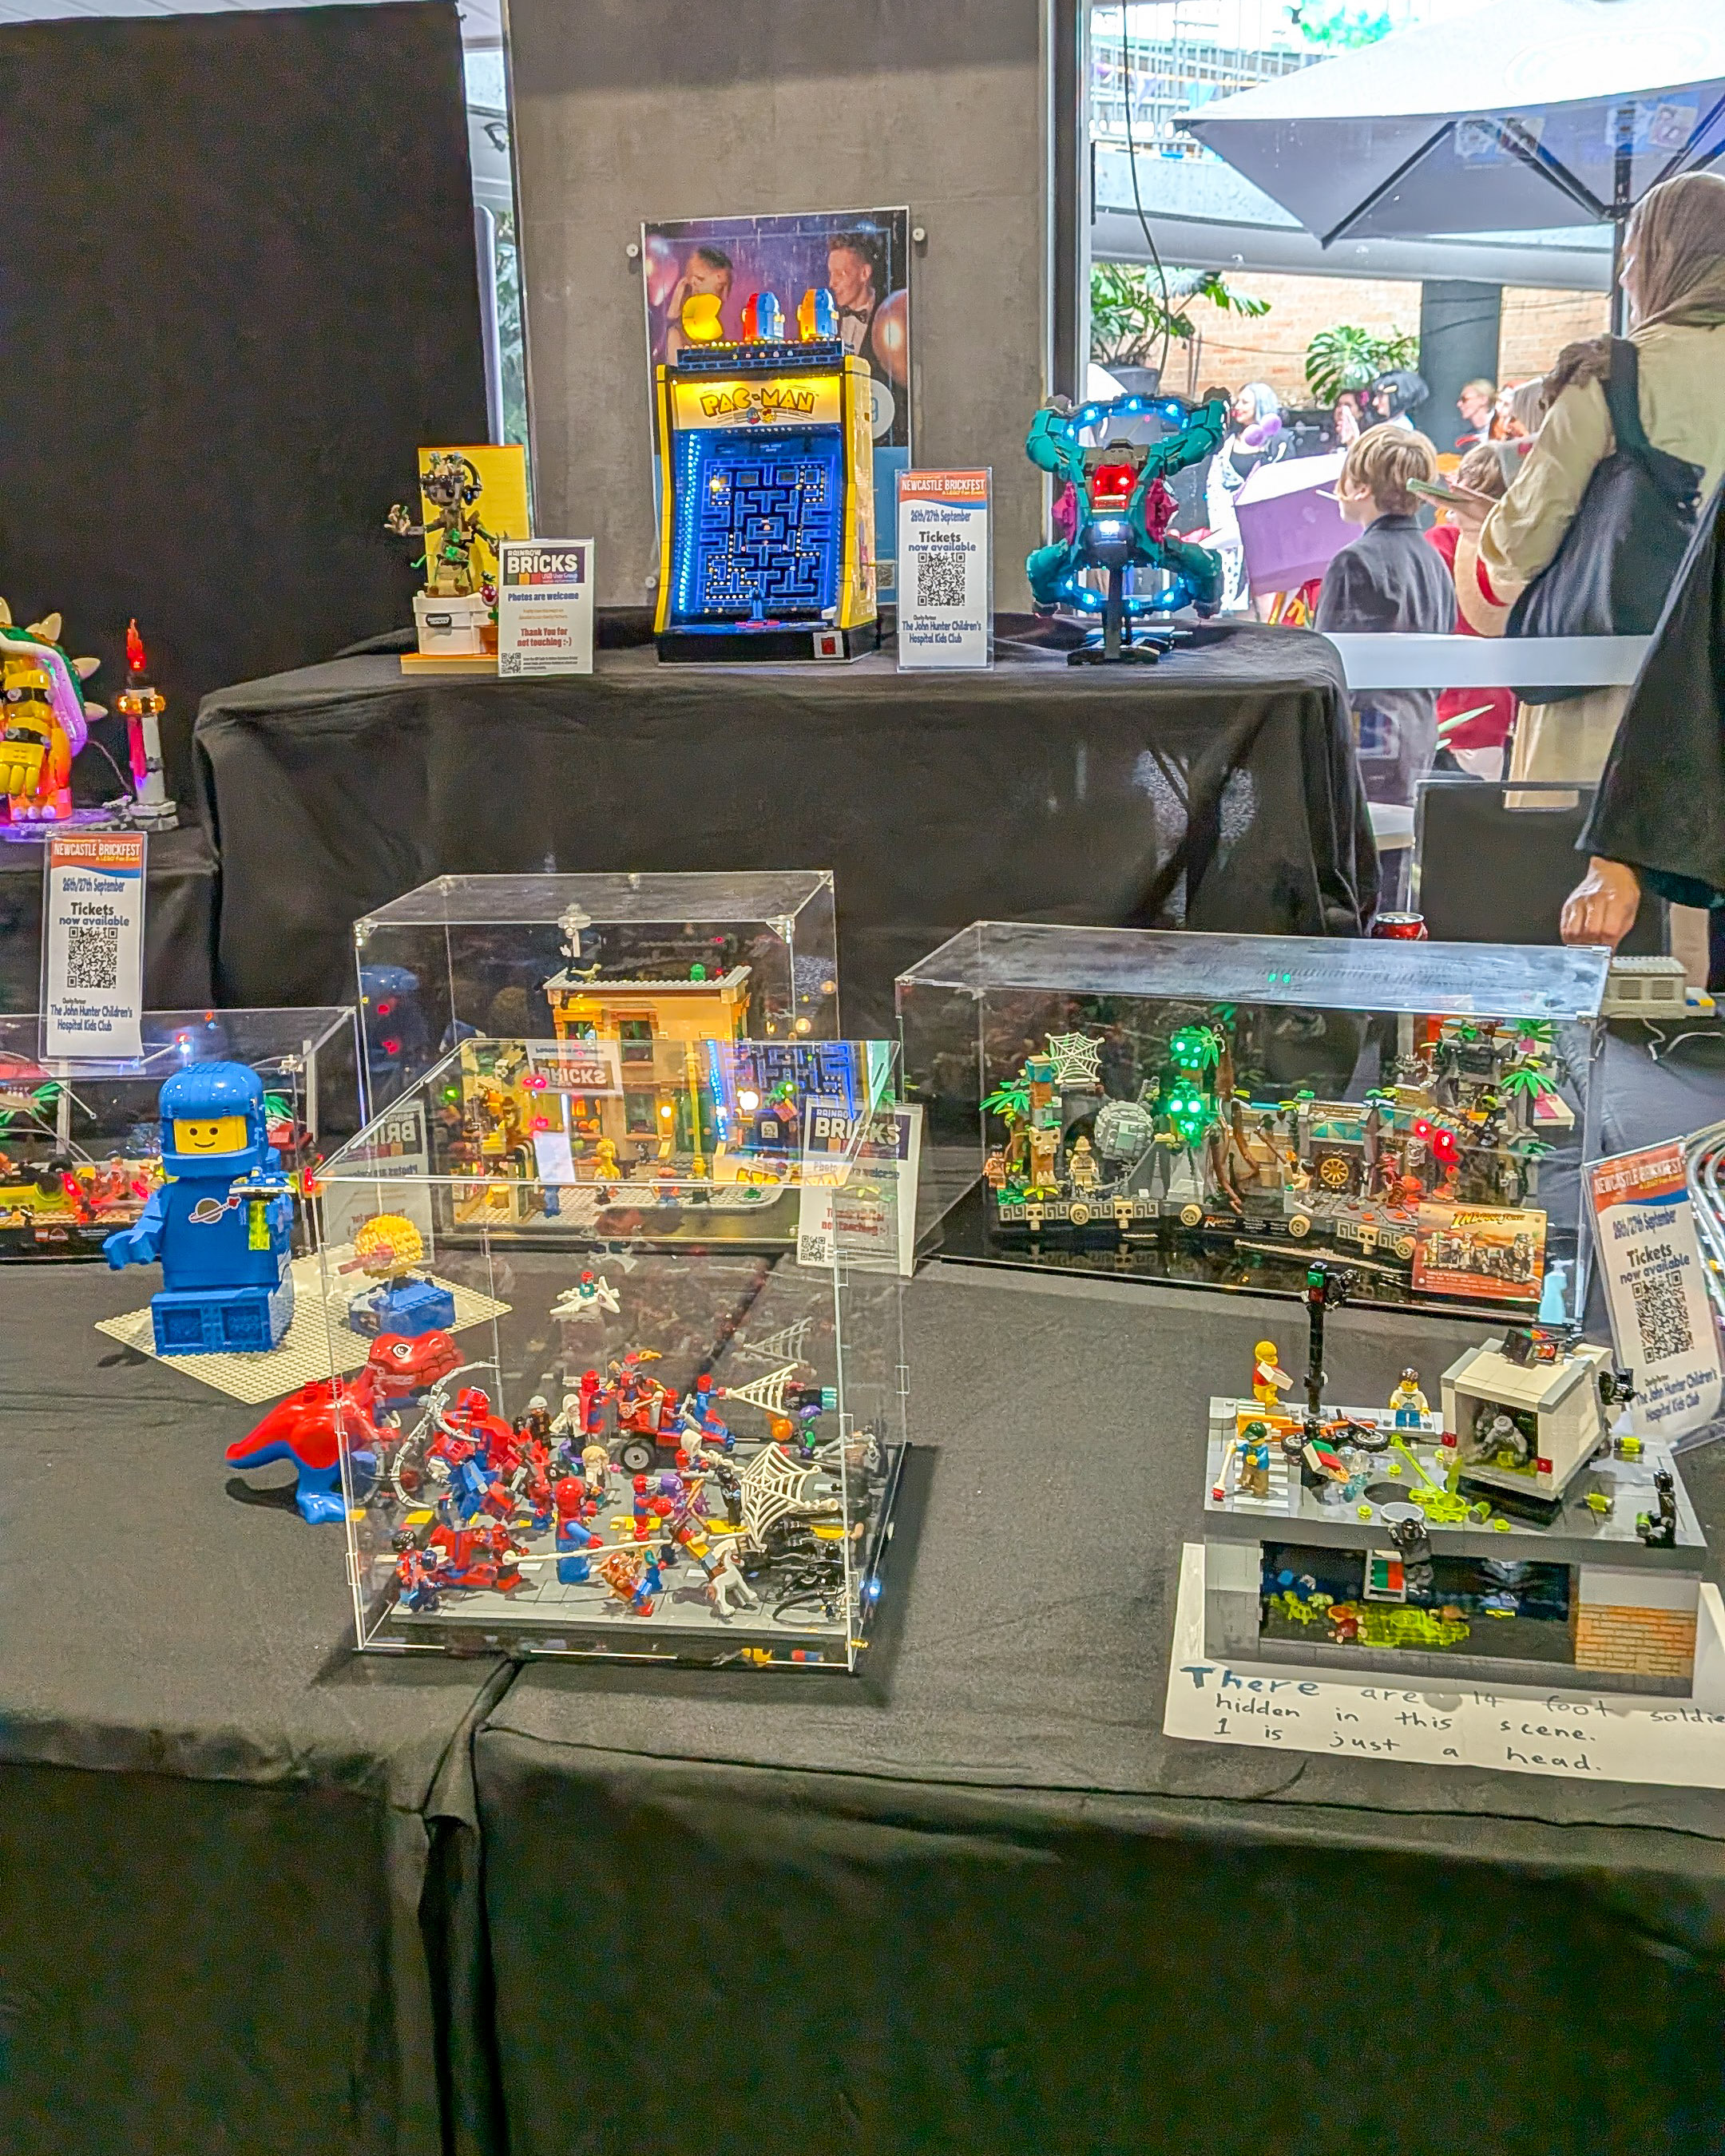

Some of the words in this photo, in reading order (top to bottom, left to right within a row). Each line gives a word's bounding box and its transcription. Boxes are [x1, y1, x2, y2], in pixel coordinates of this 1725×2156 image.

[700, 387, 815, 418] PAC-MAN
[902, 479, 942, 491] NEWCASTLE
[945, 479, 985, 490] BRICKFEST
[941, 509, 971, 525] September
[919, 531, 961, 543] Tickets
[931, 542, 976, 552] available
[507, 554, 577, 574] BRICKS
[508, 593, 532, 601] Photos
[547, 592, 579, 600] welcome
[521, 628, 542, 636] Thank
[543, 628, 556, 636] You
[557, 627, 568, 636] for
[902, 620, 913, 631] The
[914, 621, 929, 631] John
[930, 621, 950, 631] Hunter
[952, 620, 981, 631] Children's
[530, 637, 561, 648] touching
[909, 633, 934, 645] Hospital
[934, 633, 947, 643] Kids
[948, 633, 962, 644] Club
[54, 842, 96, 856] NEWCASTLE
[98, 843, 141, 856] BRICKFEST
[93, 878, 125, 896] September
[70, 902, 114, 915] Tickets
[59, 917, 80, 925] now
[82, 915, 129, 926] available
[50, 1004, 62, 1016] The
[63, 1005, 78, 1017] John
[80, 1005, 101, 1017] Hunter
[102, 1005, 133, 1018] Children's
[57, 1019, 82, 1033] Hospital
[84, 1019, 97, 1032] Kids
[98, 1019, 112, 1032] Club
[1643, 1205, 1676, 1235] September
[1626, 1243, 1672, 1267] Tickets
[1620, 1270, 1641, 1285] now
[1643, 1254, 1690, 1278] available
[1646, 1399, 1671, 1421] Hospital
[1180, 1667, 1319, 1697] There
[1361, 1687, 1420, 1703] are
[1473, 1690, 1505, 1708] 14
[1542, 1694, 1615, 1717] foot
[1216, 1693, 1300, 1718] hidden
[1336, 1707, 1359, 1722] in
[1394, 1711, 1452, 1729] this
[1500, 1720, 1596, 1742] scene.
[1214, 1718, 1231, 1735] 1
[1265, 1725, 1283, 1741] is
[1330, 1731, 1400, 1751] just
[1442, 1747, 1459, 1758] a
[1507, 1746, 1601, 1771] head.
